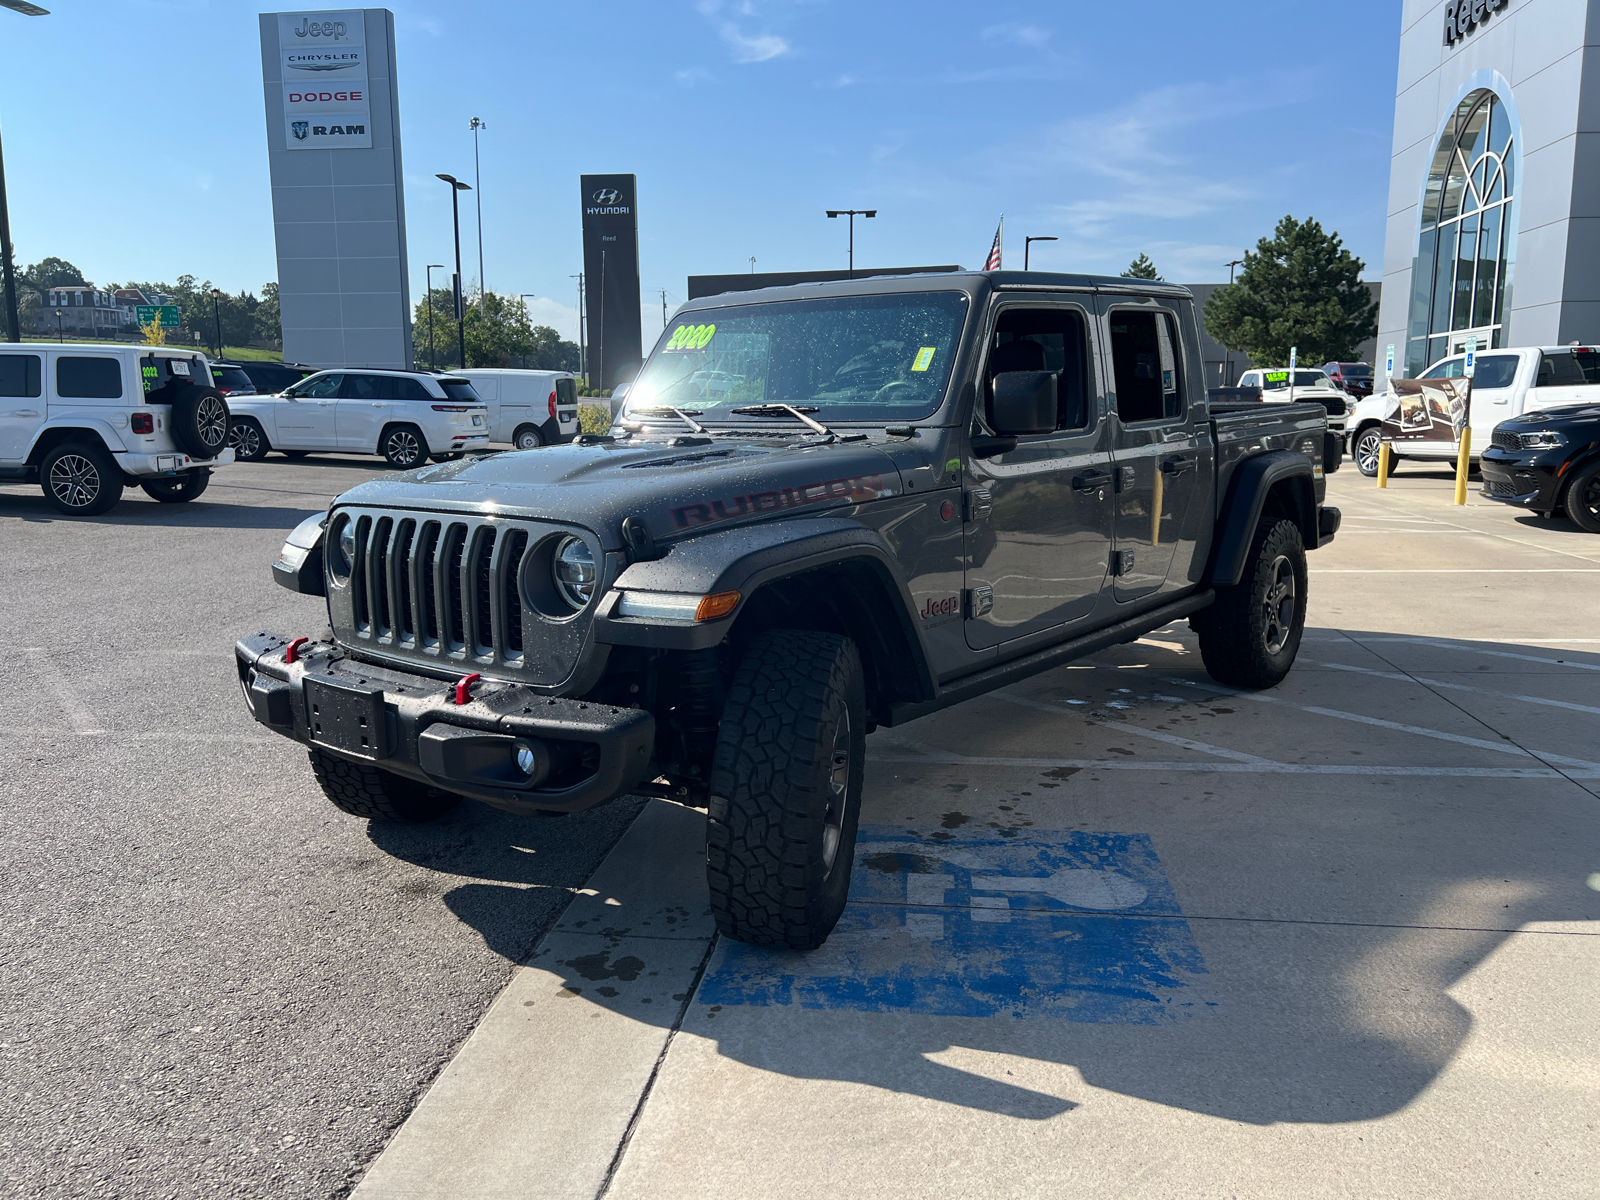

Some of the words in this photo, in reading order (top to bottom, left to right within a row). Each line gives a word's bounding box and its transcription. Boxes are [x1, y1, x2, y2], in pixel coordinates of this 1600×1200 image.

[294, 17, 348, 40] Jeep
[288, 53, 358, 62] CHRYSLER
[289, 91, 363, 103] DODGE
[312, 125, 365, 136] RAM
[587, 206, 630, 215] HYUNDAI
[665, 324, 716, 350] 2020
[142, 366, 158, 377] 2022
[669, 473, 885, 529] RUBICON
[920, 596, 958, 620] Jeep
